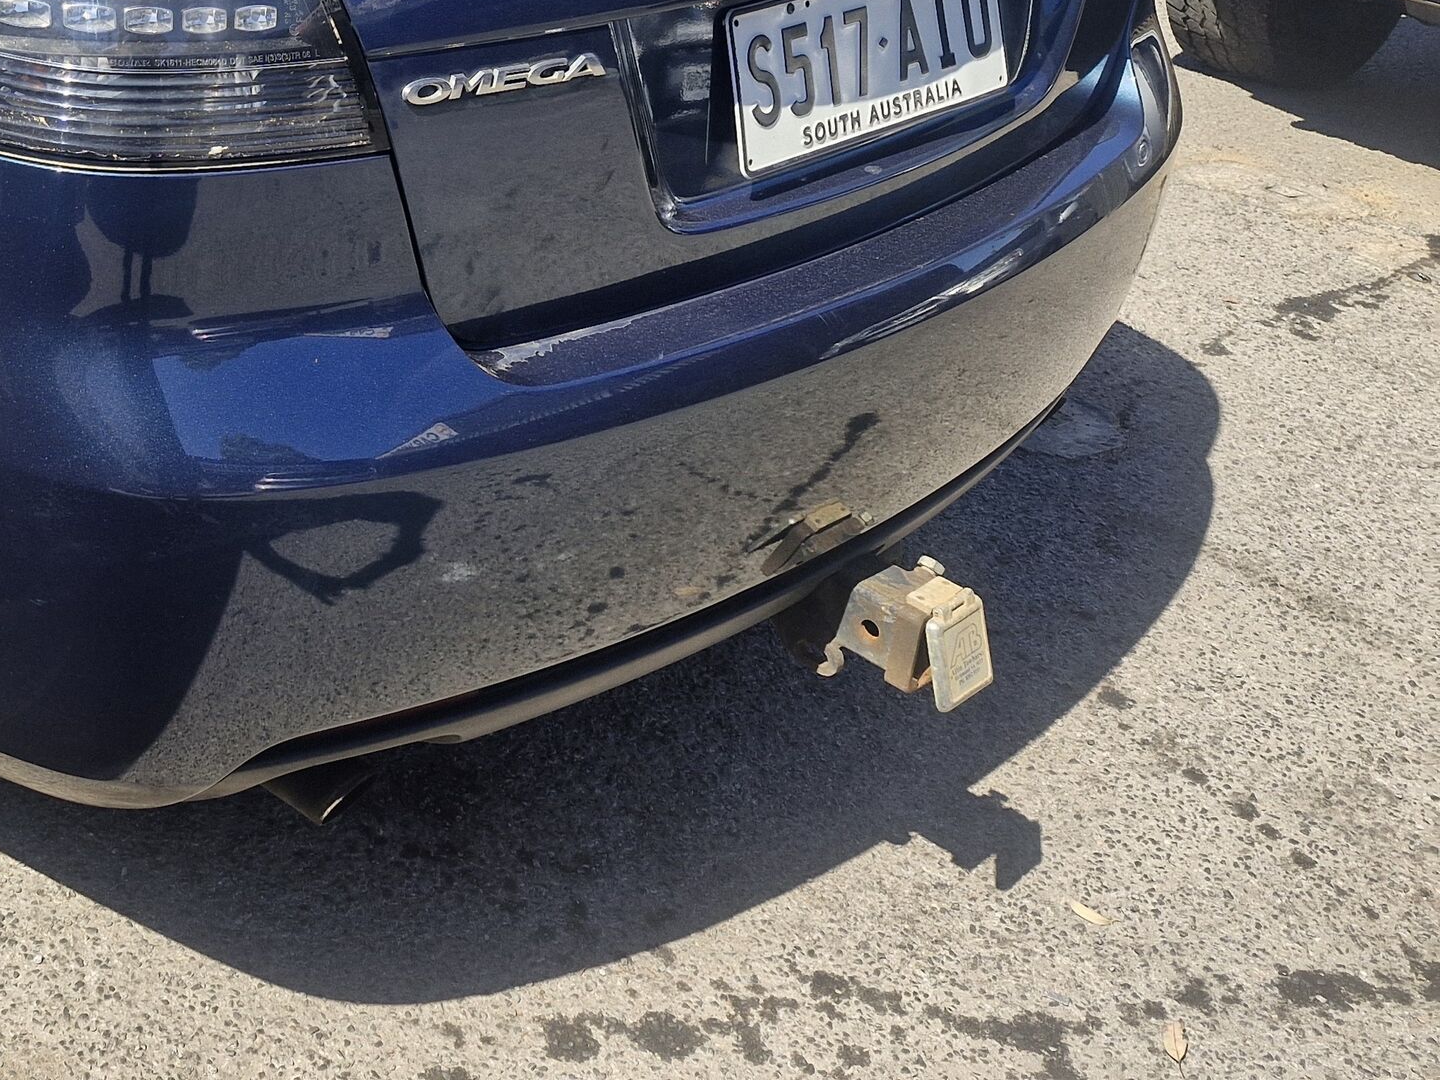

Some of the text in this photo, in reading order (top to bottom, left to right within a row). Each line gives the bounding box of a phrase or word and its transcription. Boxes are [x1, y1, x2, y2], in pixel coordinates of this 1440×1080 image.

[401, 52, 606, 106] OMEGA
[802, 78, 963, 147] SOUTH AUSTRALIA
